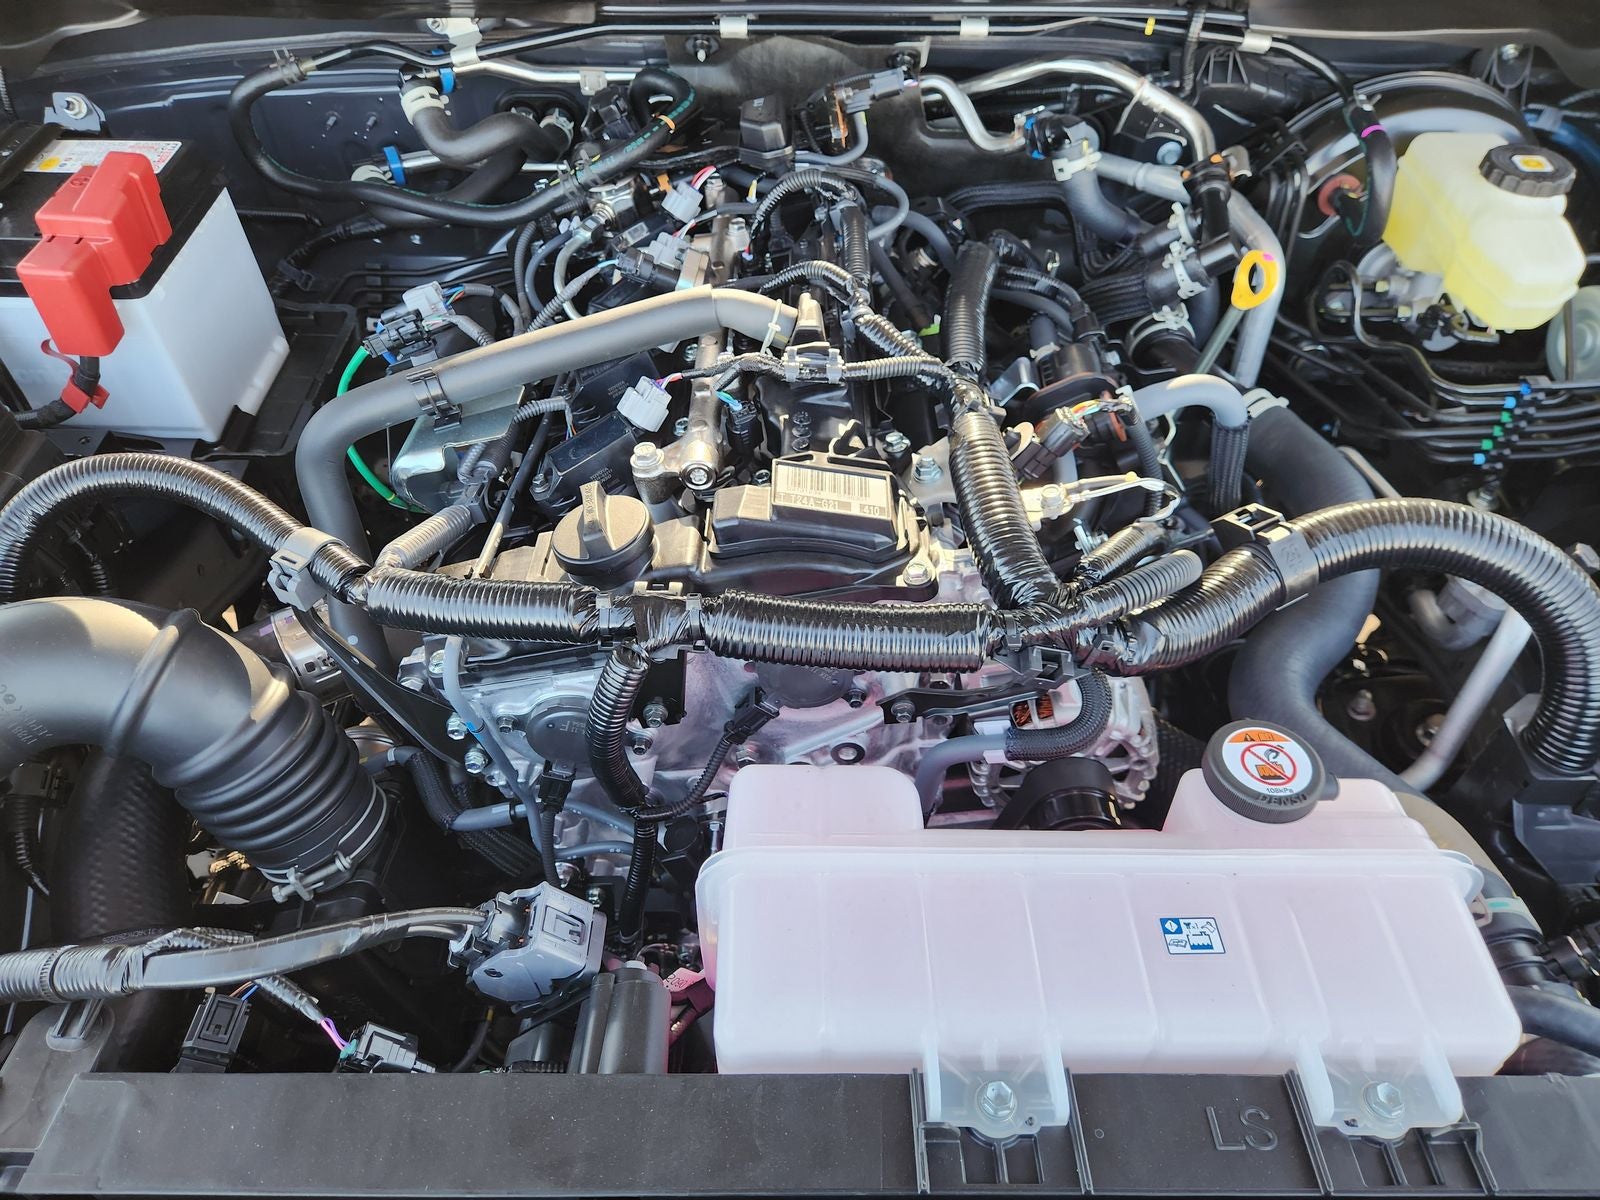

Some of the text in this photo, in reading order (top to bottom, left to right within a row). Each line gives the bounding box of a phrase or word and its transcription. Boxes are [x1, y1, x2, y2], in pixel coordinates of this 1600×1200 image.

[863, 505, 881, 517] 410
[1260, 793, 1307, 806] DENSO
[1205, 1105, 1278, 1151] LS
